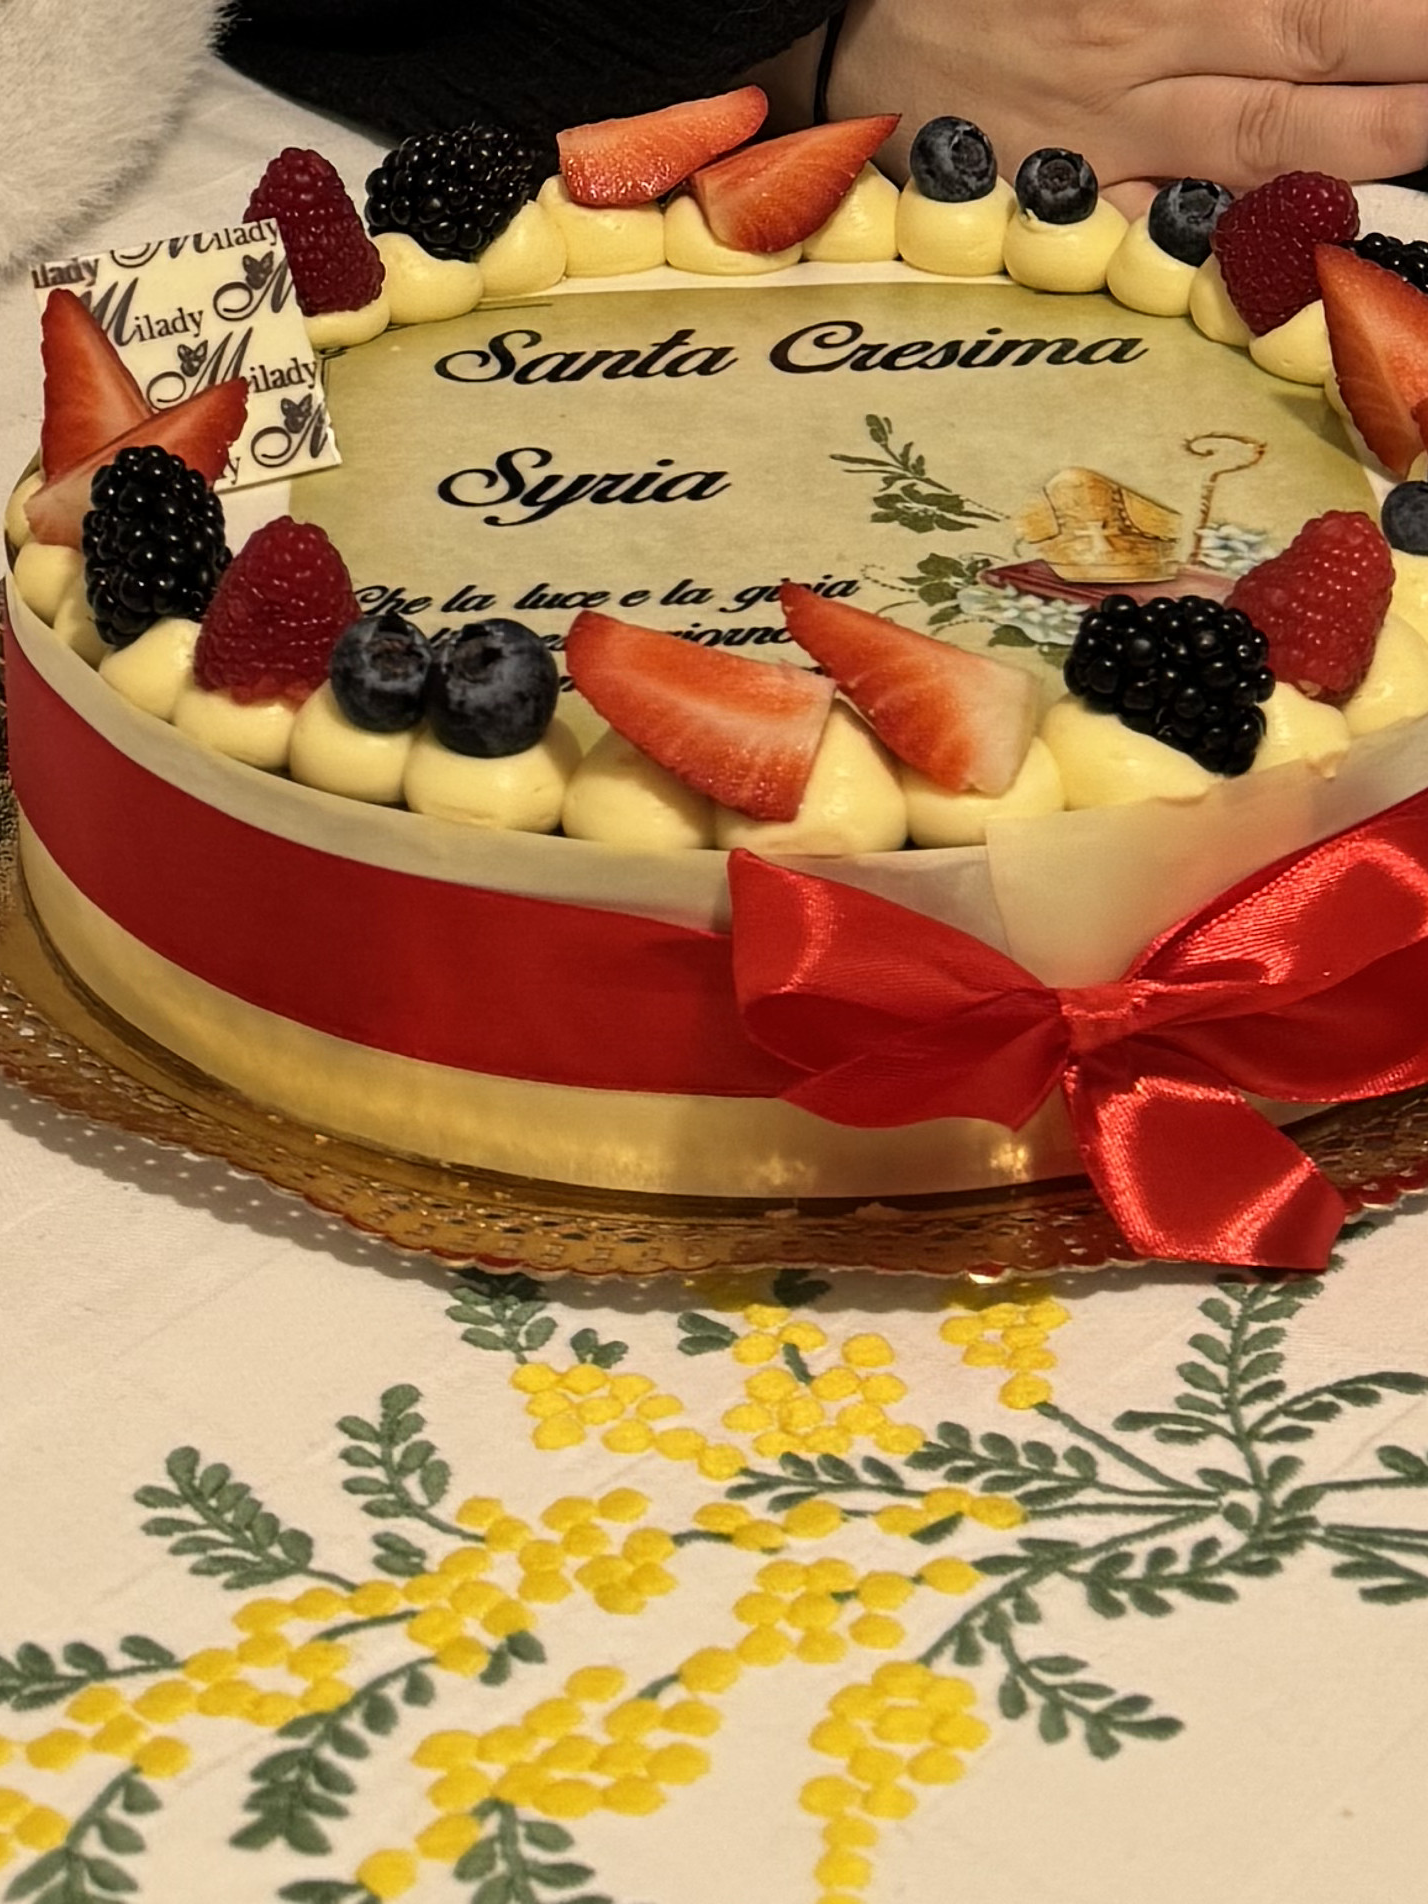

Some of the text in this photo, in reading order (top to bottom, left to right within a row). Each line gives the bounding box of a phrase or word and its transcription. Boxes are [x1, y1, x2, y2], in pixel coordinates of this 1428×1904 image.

[31, 257, 100, 290] ilady
[79, 276, 204, 347] Milady
[433, 319, 1150, 385] Santa Cresima
[436, 446, 733, 527] Syria
[354, 574, 861, 616] Che la luce e la giia
[668, 622, 794, 647] iorno
